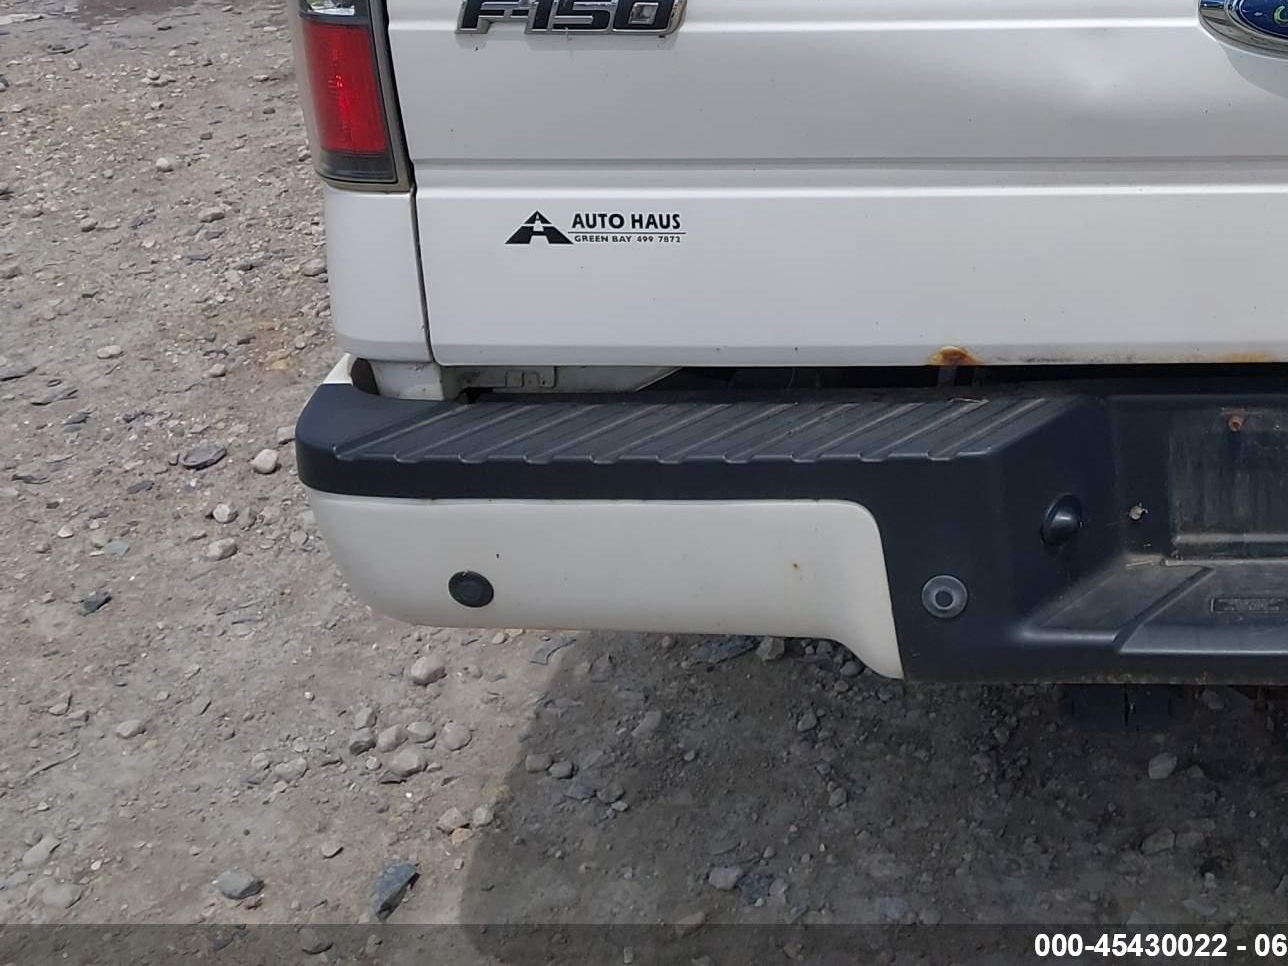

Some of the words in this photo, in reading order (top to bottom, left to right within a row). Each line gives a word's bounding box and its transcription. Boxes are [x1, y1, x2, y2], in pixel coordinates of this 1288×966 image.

[572, 213, 625, 229] AUTO
[631, 213, 681, 229] HAUS
[636, 235, 654, 243] 499
[658, 235, 681, 243] 7872
